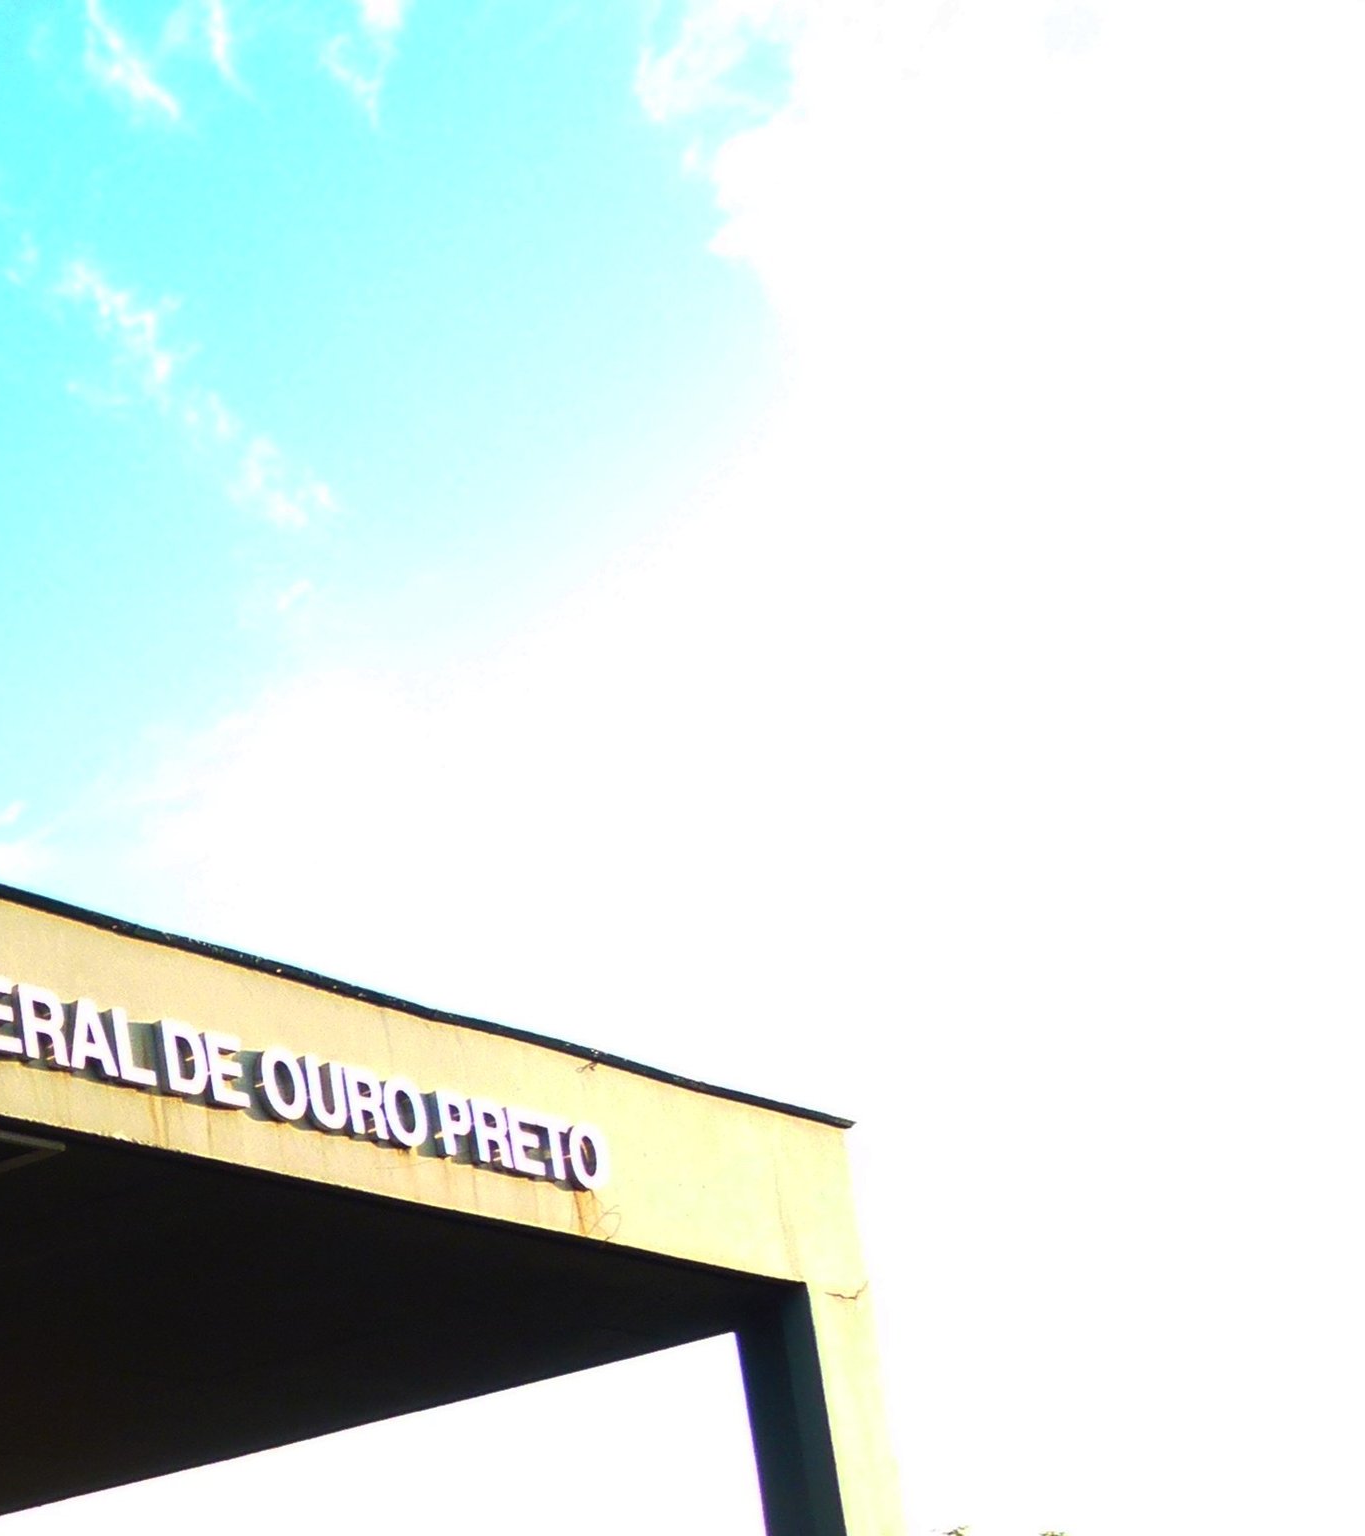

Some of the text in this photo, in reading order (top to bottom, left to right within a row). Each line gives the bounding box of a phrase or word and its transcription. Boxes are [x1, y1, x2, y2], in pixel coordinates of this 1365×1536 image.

[157, 1020, 251, 1109] DE
[256, 1048, 428, 1149] OURO
[433, 1090, 609, 1191] PRETO
